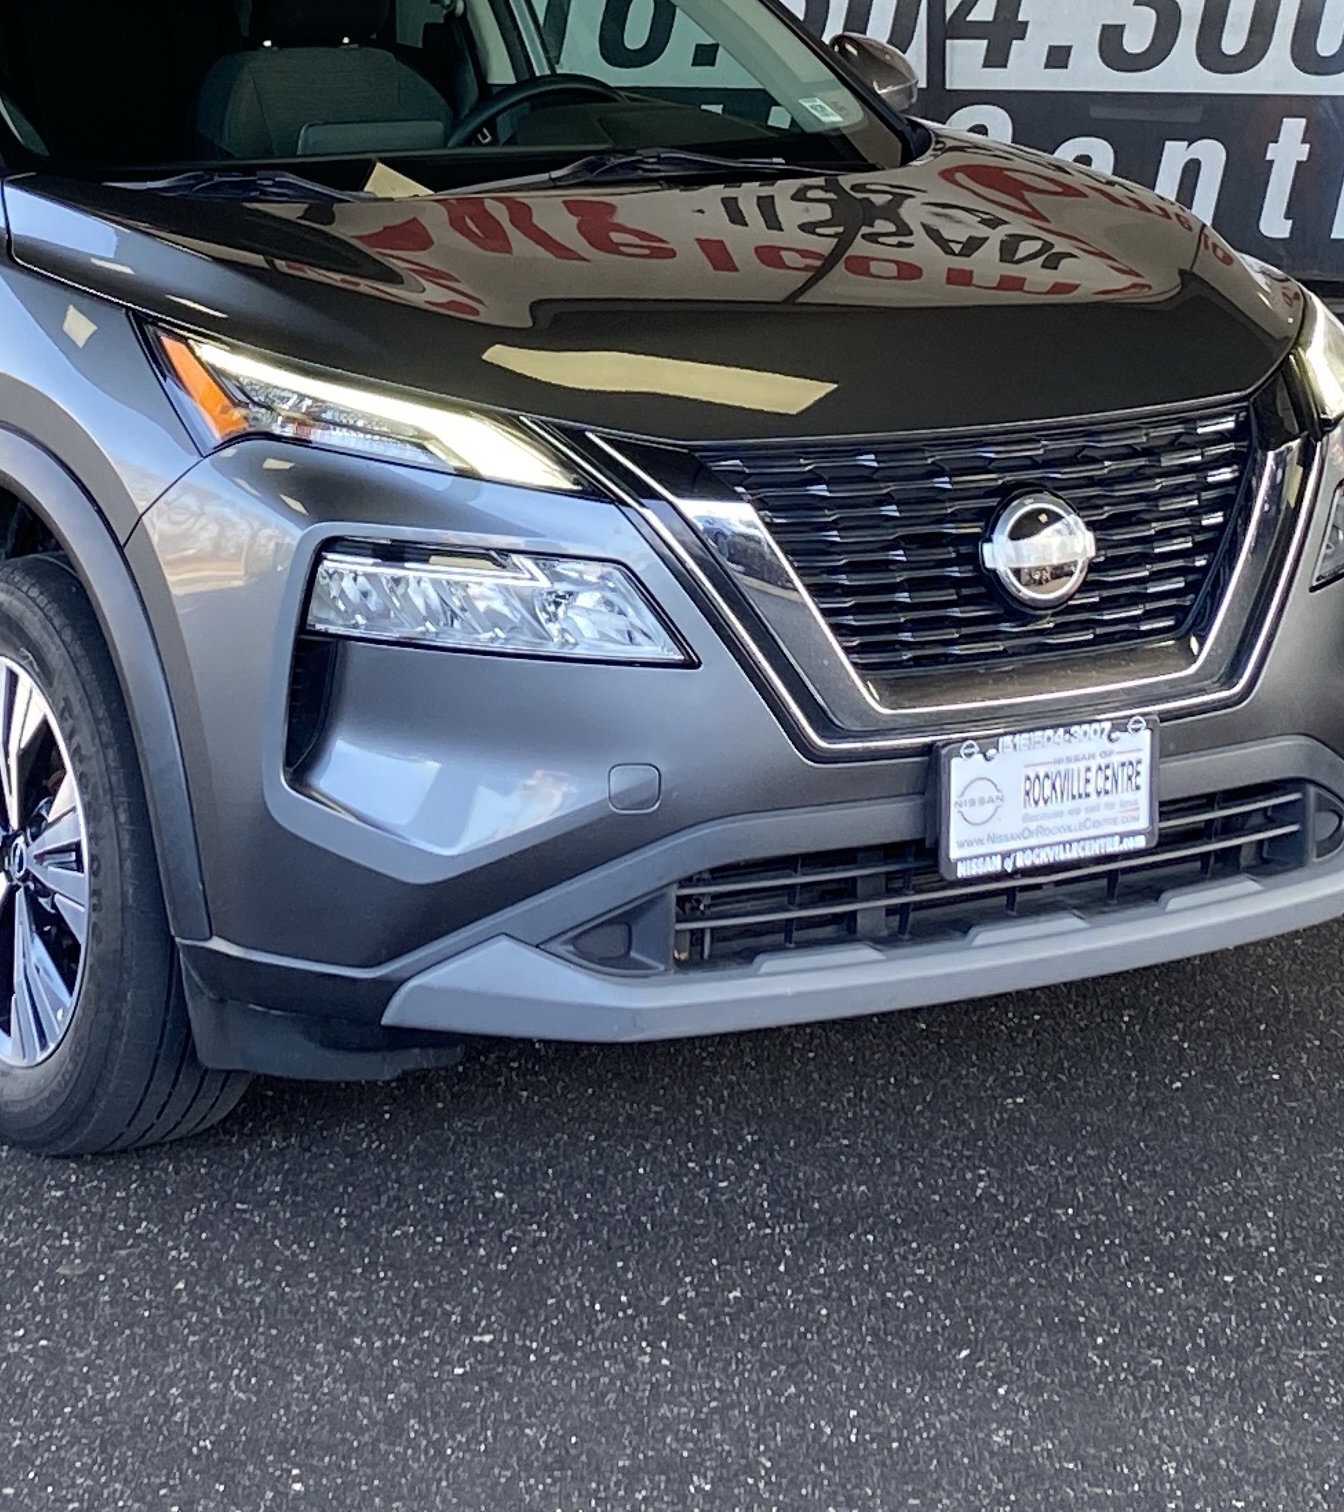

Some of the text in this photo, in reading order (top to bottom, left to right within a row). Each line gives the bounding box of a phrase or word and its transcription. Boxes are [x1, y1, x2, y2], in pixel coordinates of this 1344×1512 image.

[1023, 760, 1142, 808] ROCKVILLE CENTRE
[954, 792, 1004, 808] NISSAN
[957, 855, 1001, 878] NISSAN
